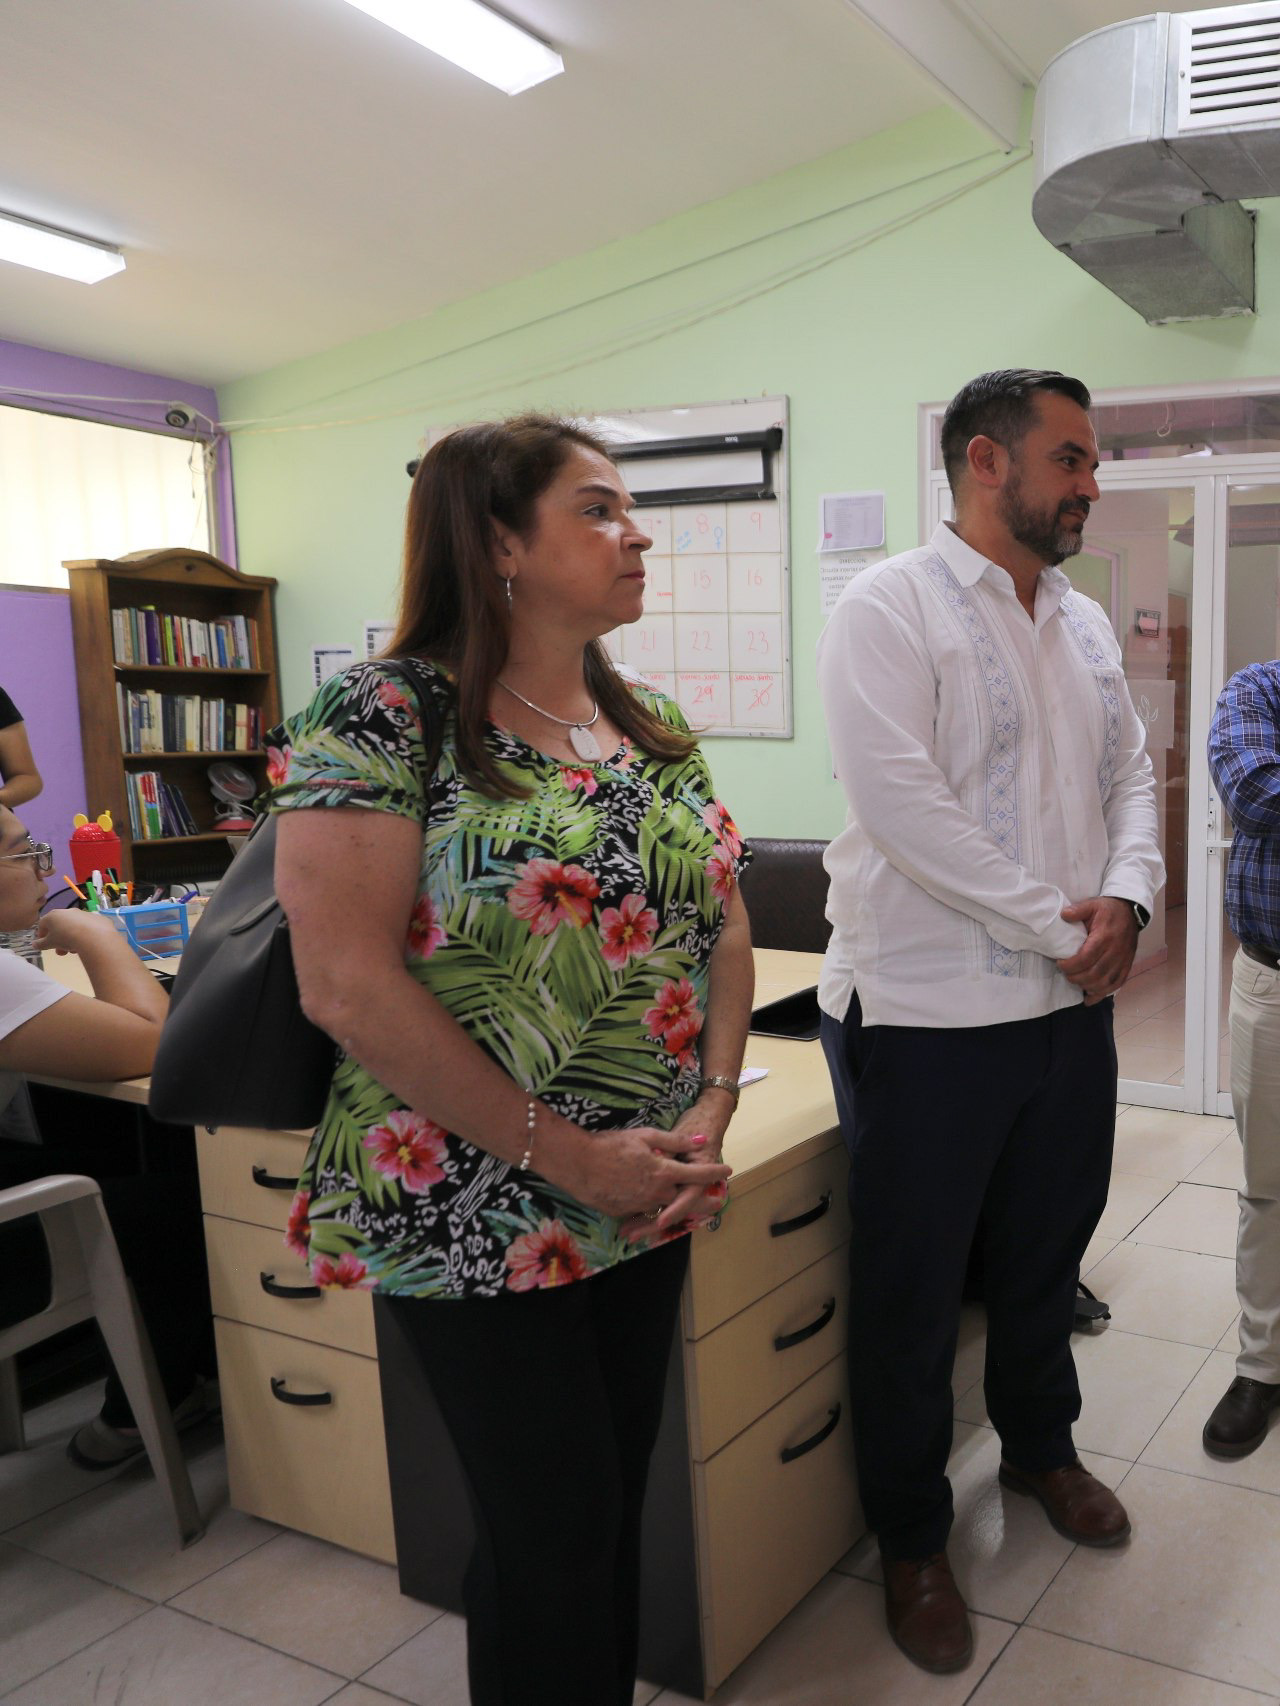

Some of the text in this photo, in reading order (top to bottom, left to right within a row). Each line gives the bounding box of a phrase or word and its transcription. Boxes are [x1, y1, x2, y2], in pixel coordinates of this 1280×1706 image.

[695, 513, 709, 534] 8
[750, 511, 762, 532] 9
[693, 569, 711, 589] 15
[747, 568, 762, 586] 16
[640, 630, 656, 652] 21
[692, 630, 713, 651] 22
[747, 630, 769, 654] 23
[692, 683, 714, 705] 29
